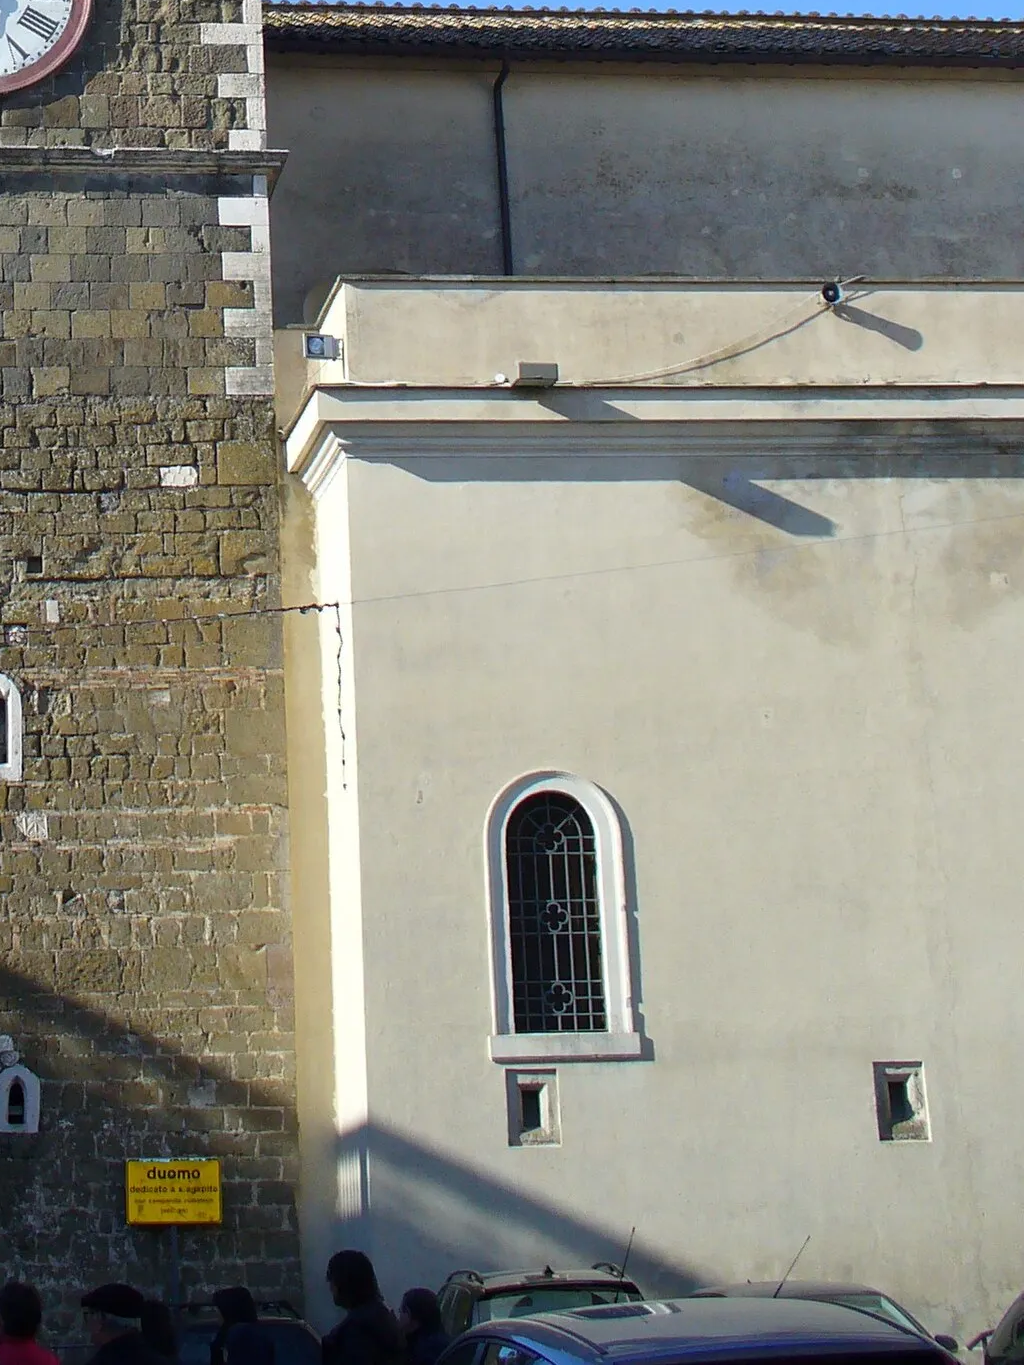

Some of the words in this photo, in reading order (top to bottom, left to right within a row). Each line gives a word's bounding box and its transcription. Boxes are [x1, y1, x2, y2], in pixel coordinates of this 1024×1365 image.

[6, 34, 30, 65] V
[147, 1167, 200, 1179] duomo
[130, 1185, 168, 1193] dedicato
